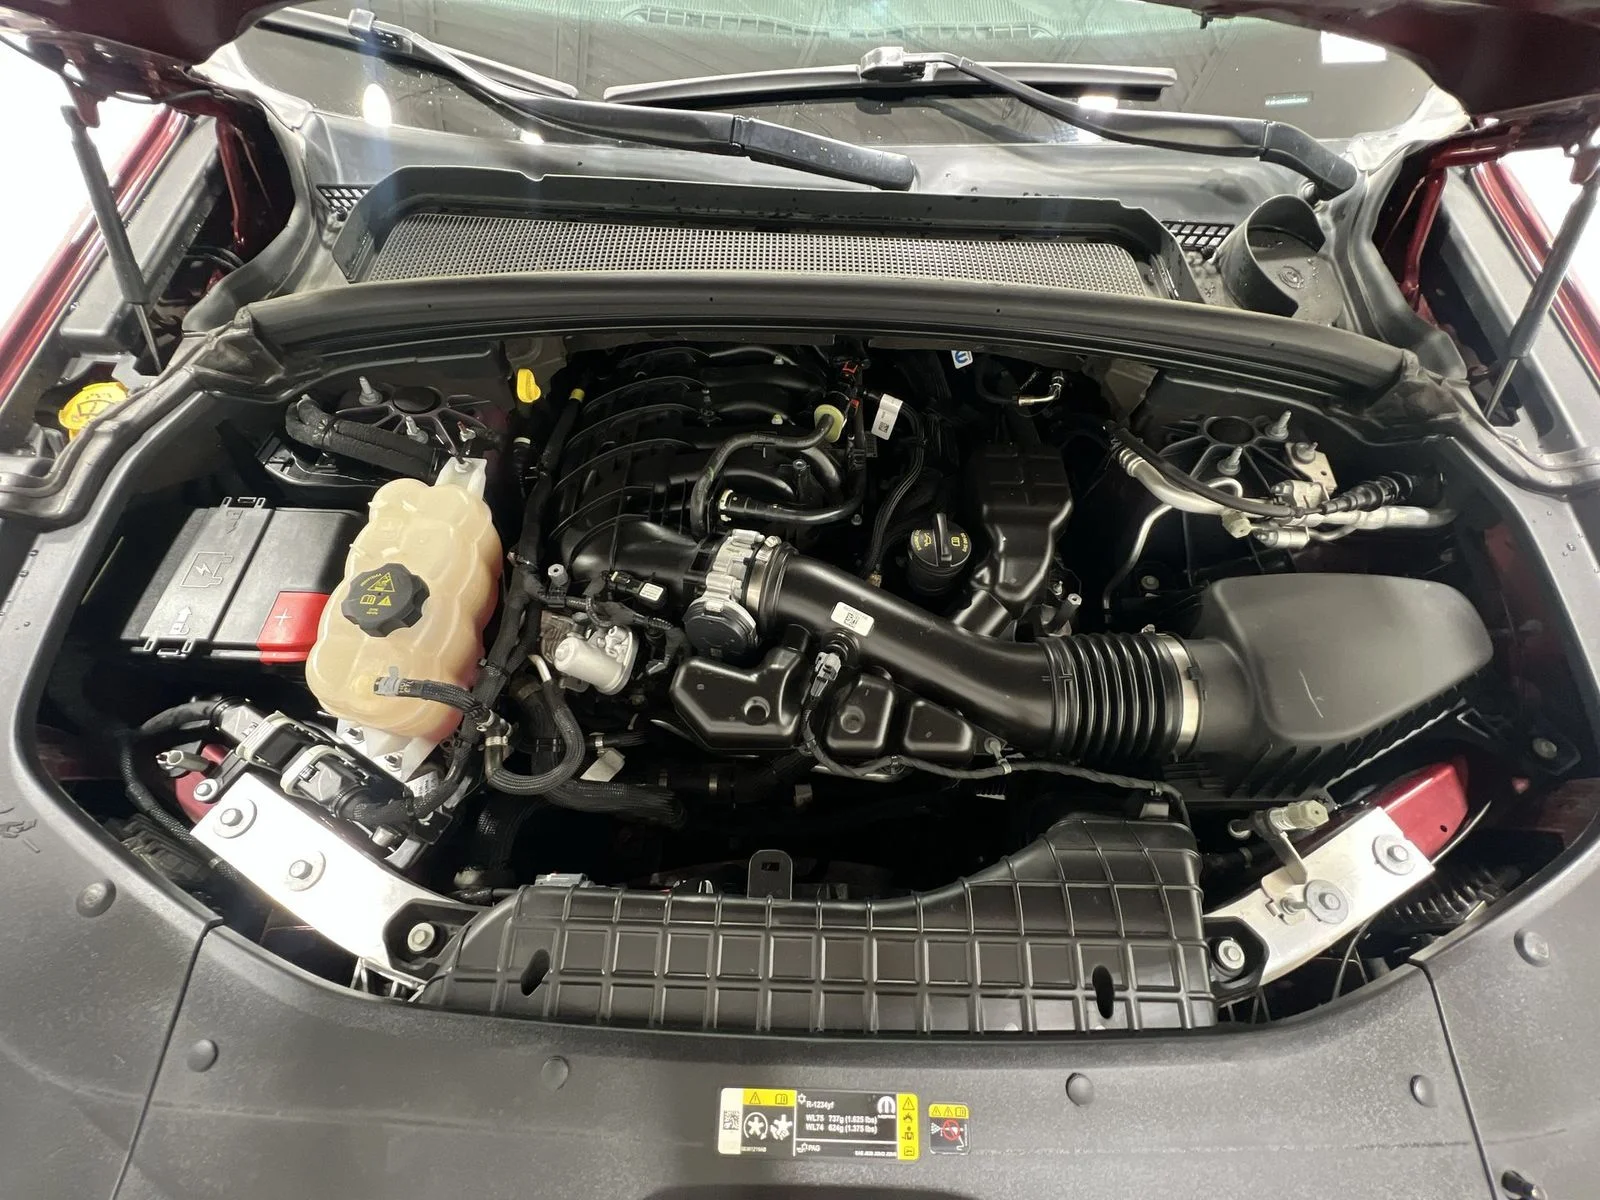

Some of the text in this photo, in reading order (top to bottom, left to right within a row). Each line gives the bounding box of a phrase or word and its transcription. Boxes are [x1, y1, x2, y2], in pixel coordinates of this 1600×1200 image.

[806, 1101, 834, 1110] R-1234yf
[806, 1114, 824, 1122] WL75
[828, 1114, 844, 1124] 737g
[806, 1123, 824, 1131] WL74
